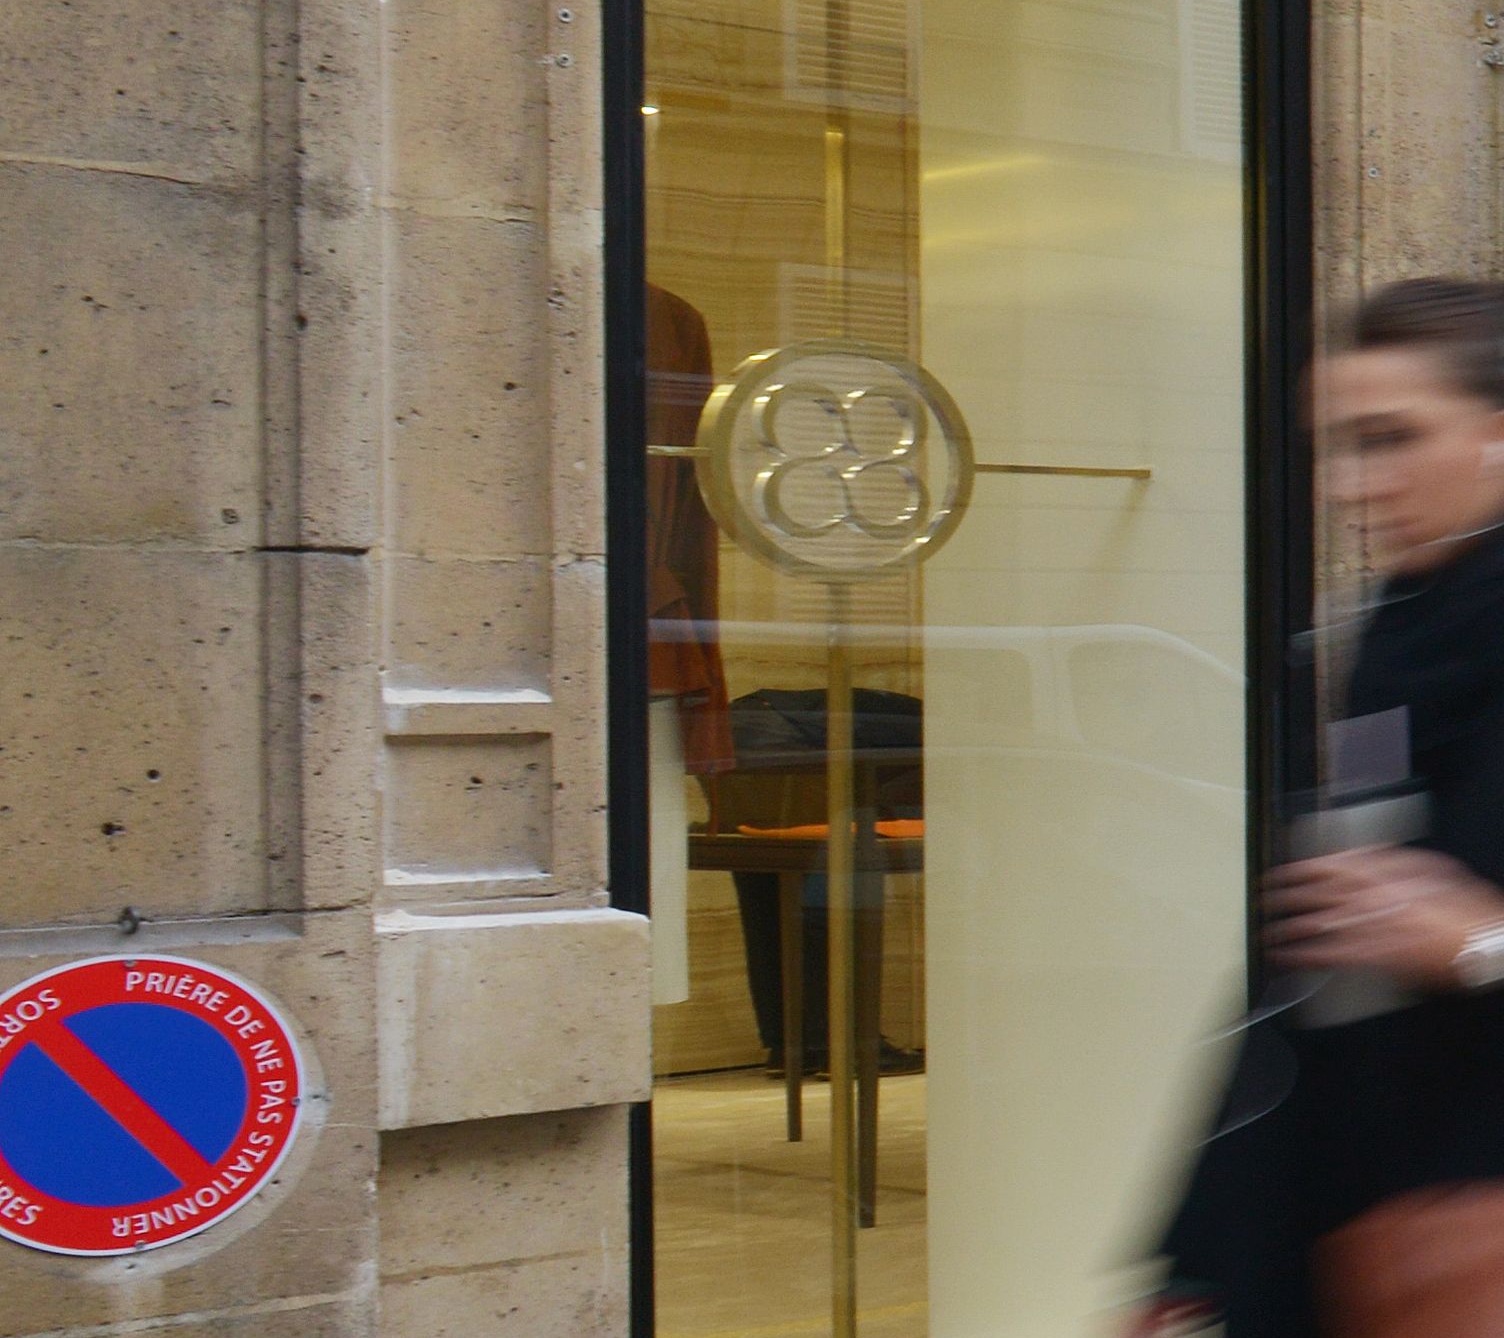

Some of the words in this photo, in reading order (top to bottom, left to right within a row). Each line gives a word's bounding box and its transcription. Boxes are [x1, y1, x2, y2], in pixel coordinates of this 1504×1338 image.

[126, 970, 229, 1012] PRIÈRE
[225, 1006, 265, 1039] DE
[250, 1039, 283, 1073] NE
[257, 1080, 286, 1125] PAS
[112, 1131, 274, 1237] STATIONNER
